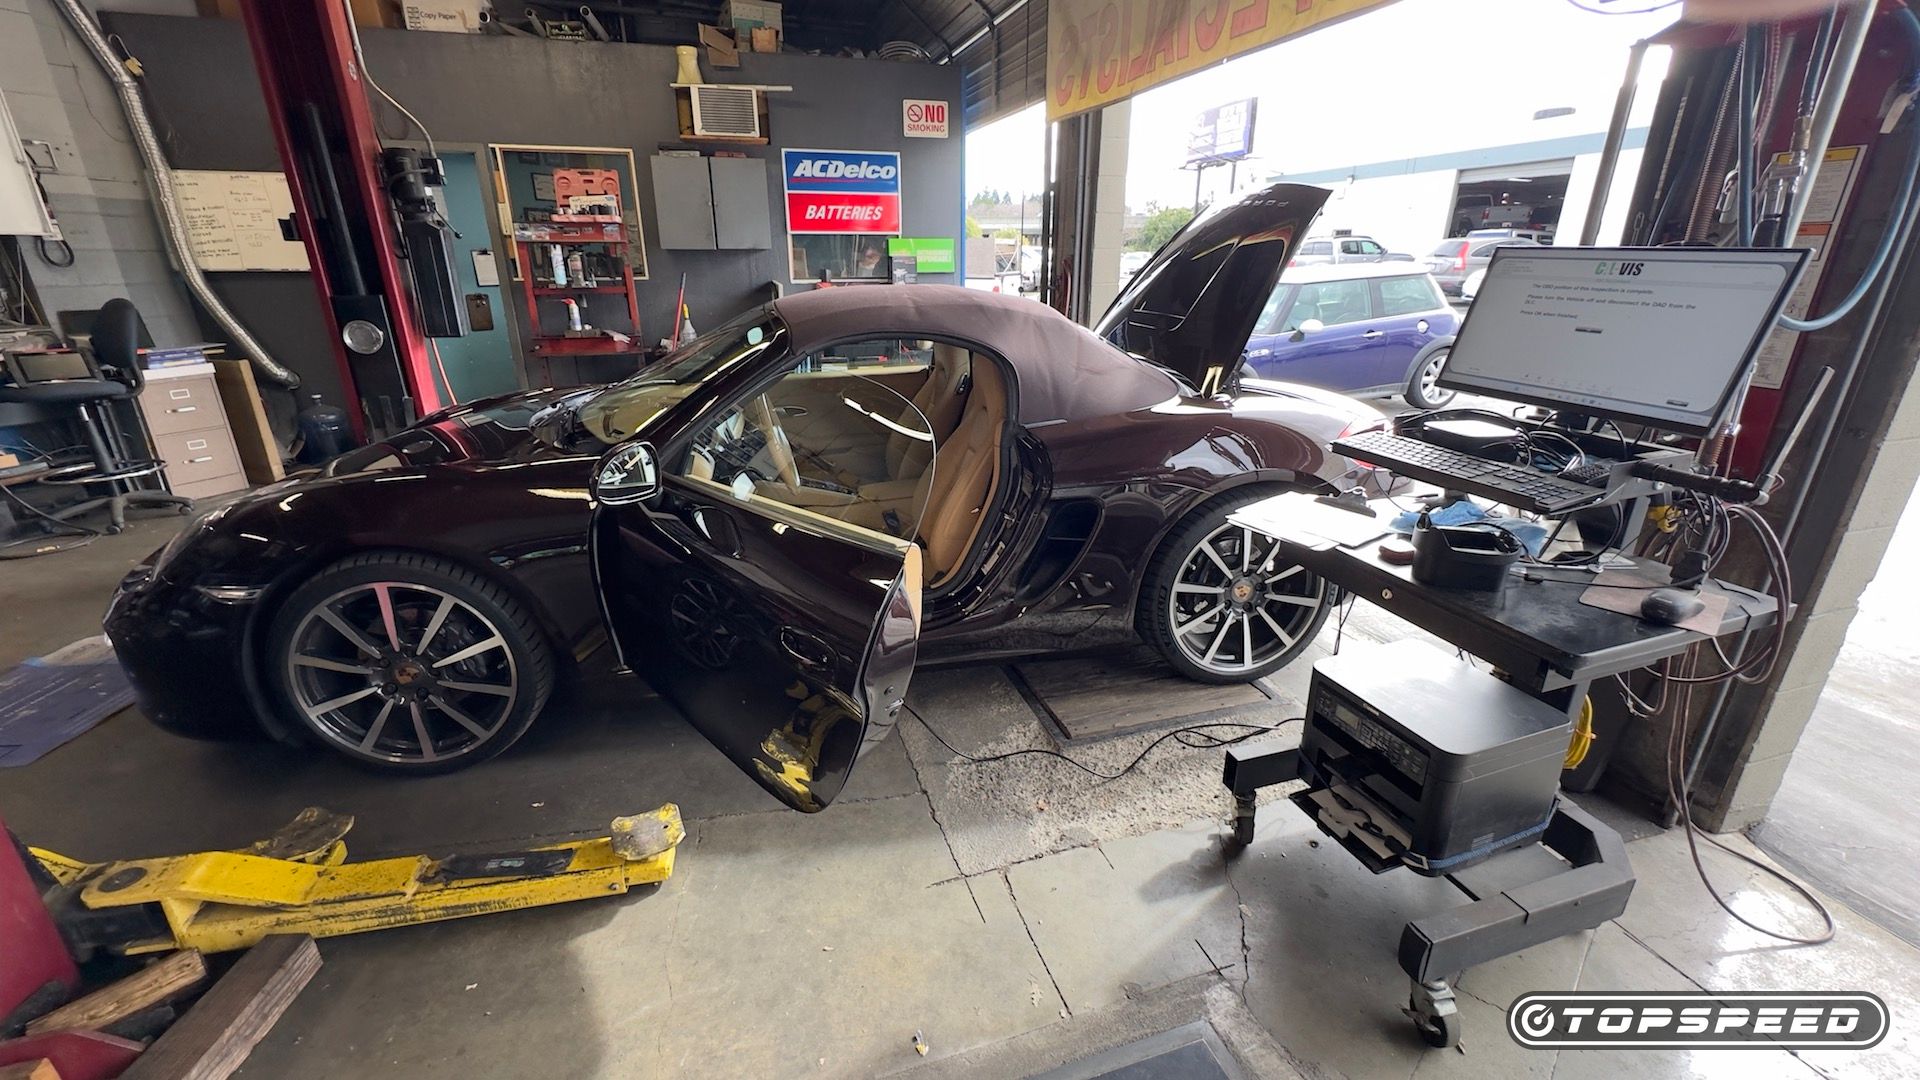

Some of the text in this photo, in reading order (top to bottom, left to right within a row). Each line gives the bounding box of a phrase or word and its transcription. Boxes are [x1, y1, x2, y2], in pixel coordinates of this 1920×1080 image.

[420, 11, 456, 20] Copy Paper
[924, 104, 945, 123] NO
[907, 123, 945, 133] SMOKING
[792, 159, 897, 179] ACDelco
[805, 204, 883, 221] BATTERIES
